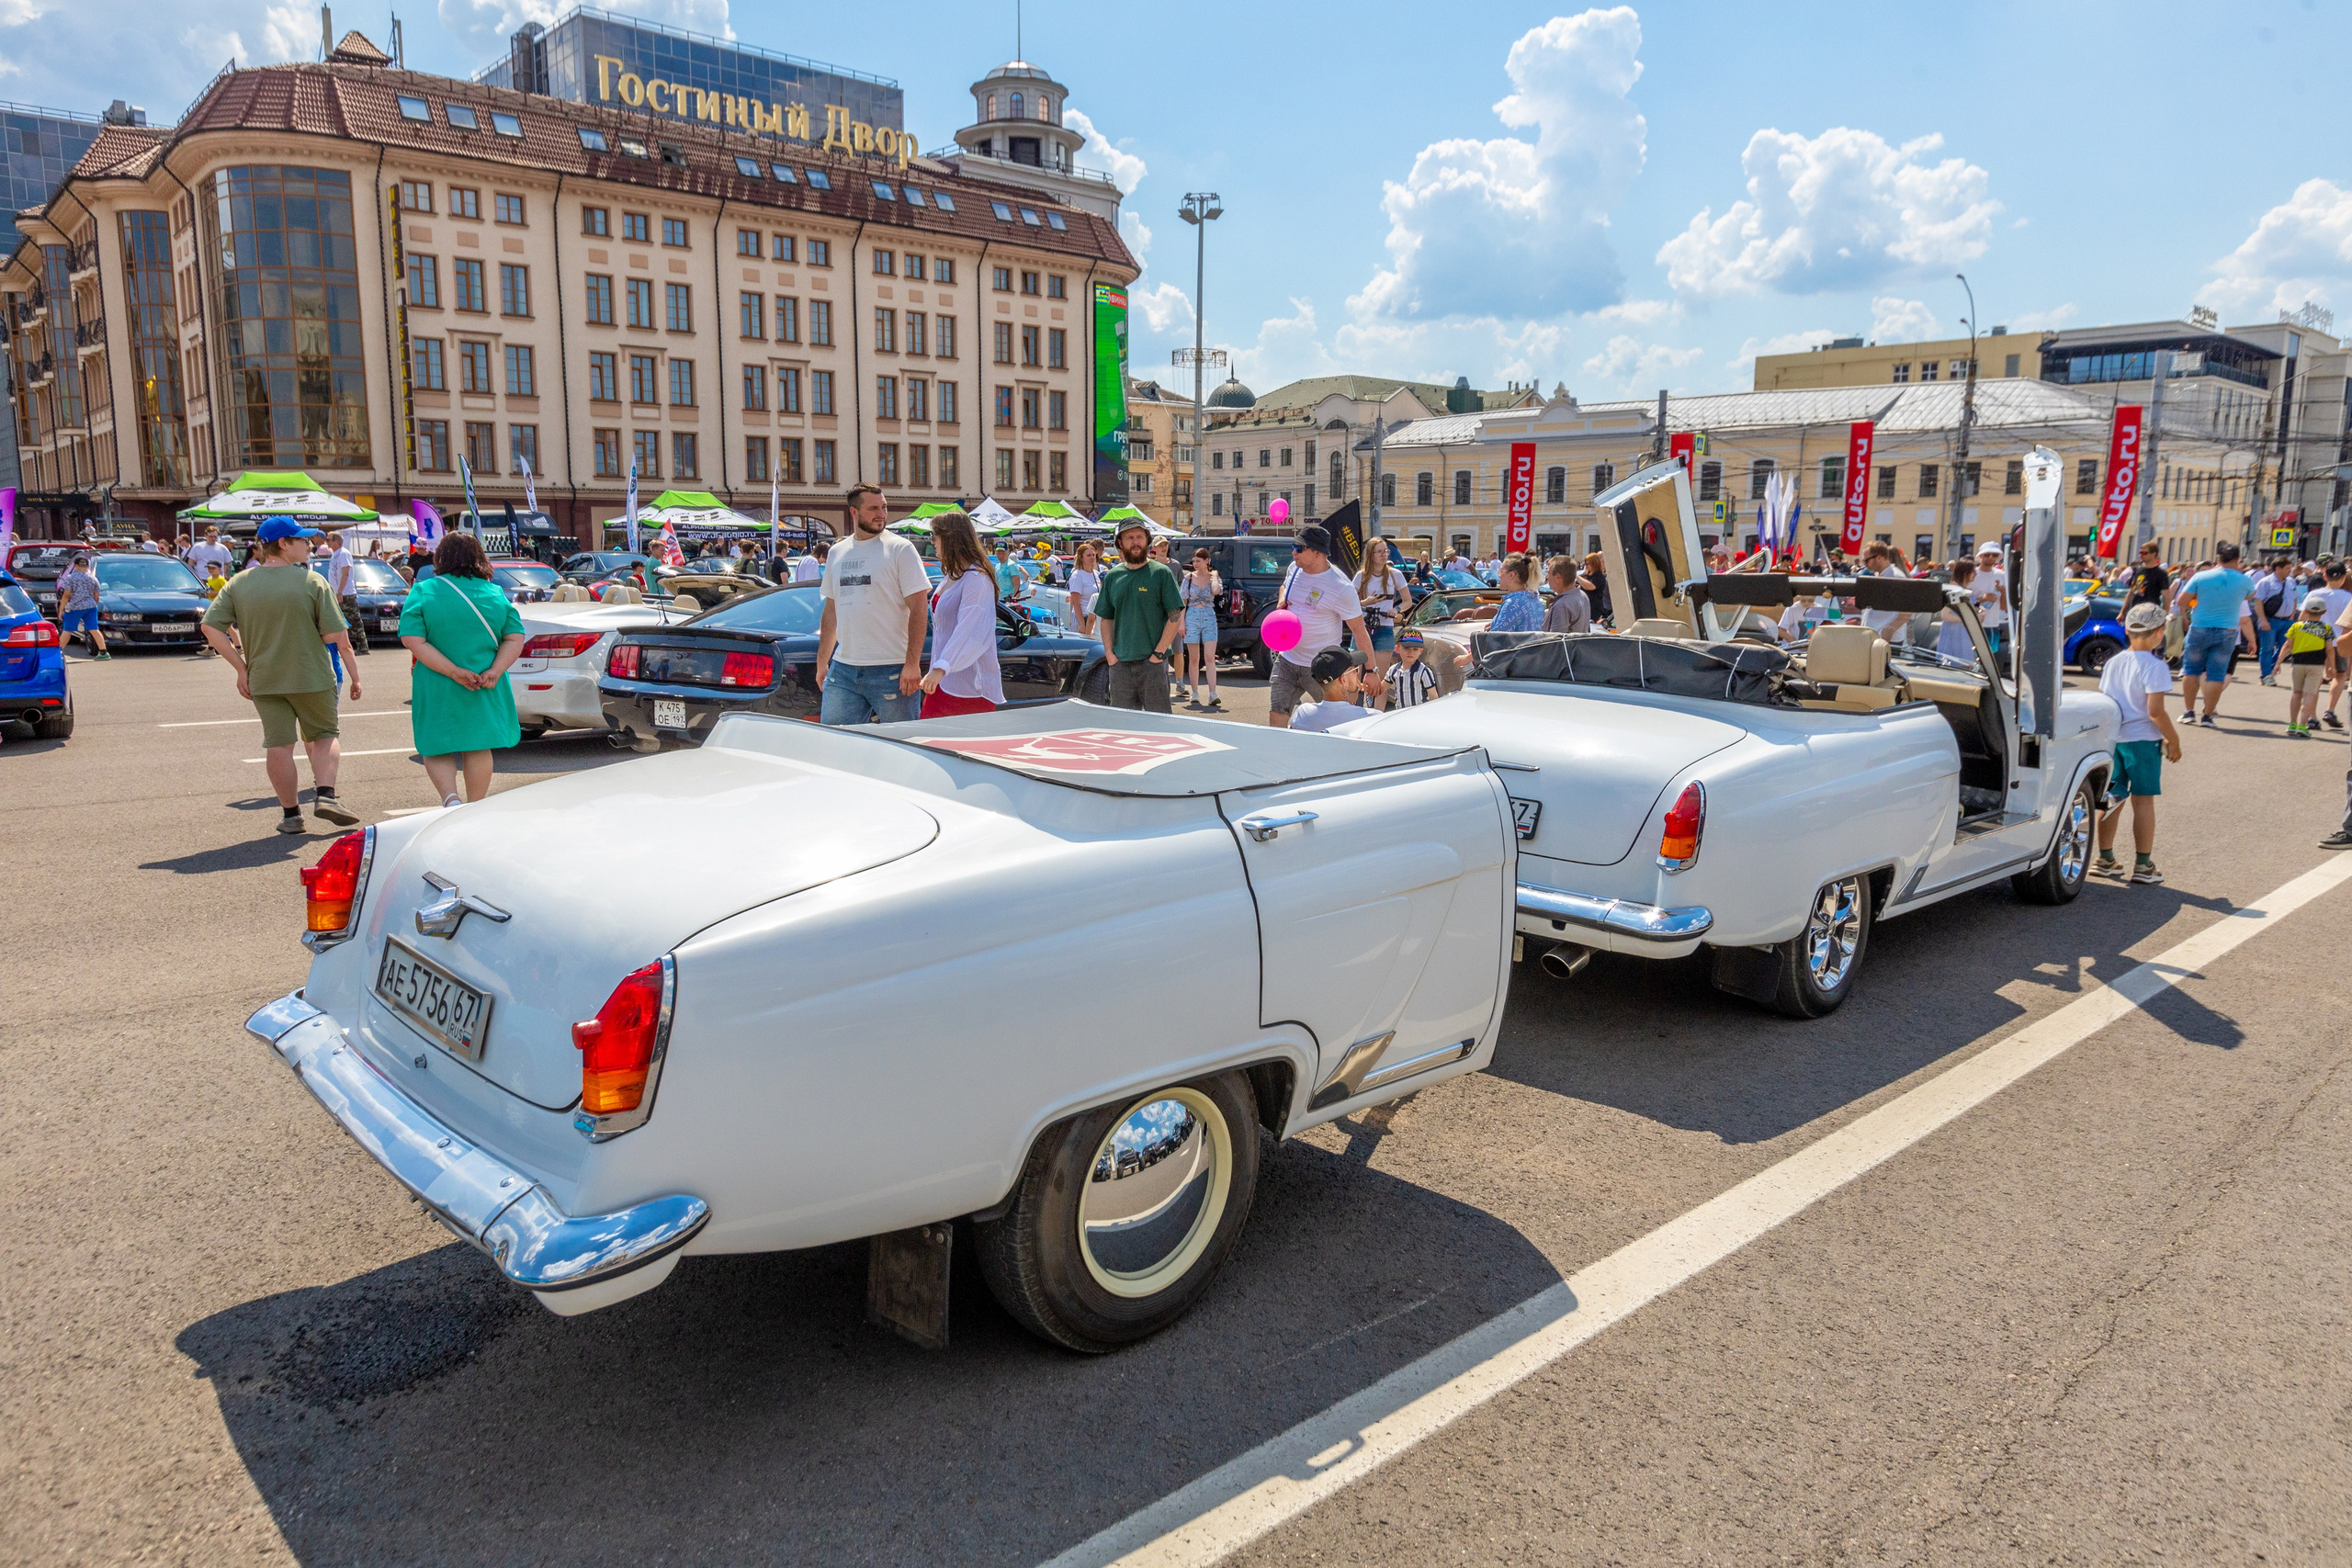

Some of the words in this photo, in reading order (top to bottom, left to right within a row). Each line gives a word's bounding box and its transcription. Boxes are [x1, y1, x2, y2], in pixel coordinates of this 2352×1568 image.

[594, 53, 810, 141] Гостиный
[823, 103, 919, 171] Двор
[1512, 457, 1532, 543] auto.ru
[1847, 437, 1869, 542] auto.ru
[2100, 424, 2137, 542] auto.ru
[687, 531, 756, 539] www.di-audio.ru
[658, 714, 670, 725] ОЕ
[666, 702, 681, 713] 475
[406, 963, 452, 1026] 5756
[453, 989, 476, 1029] 67
[448, 1022, 463, 1043] RUS
